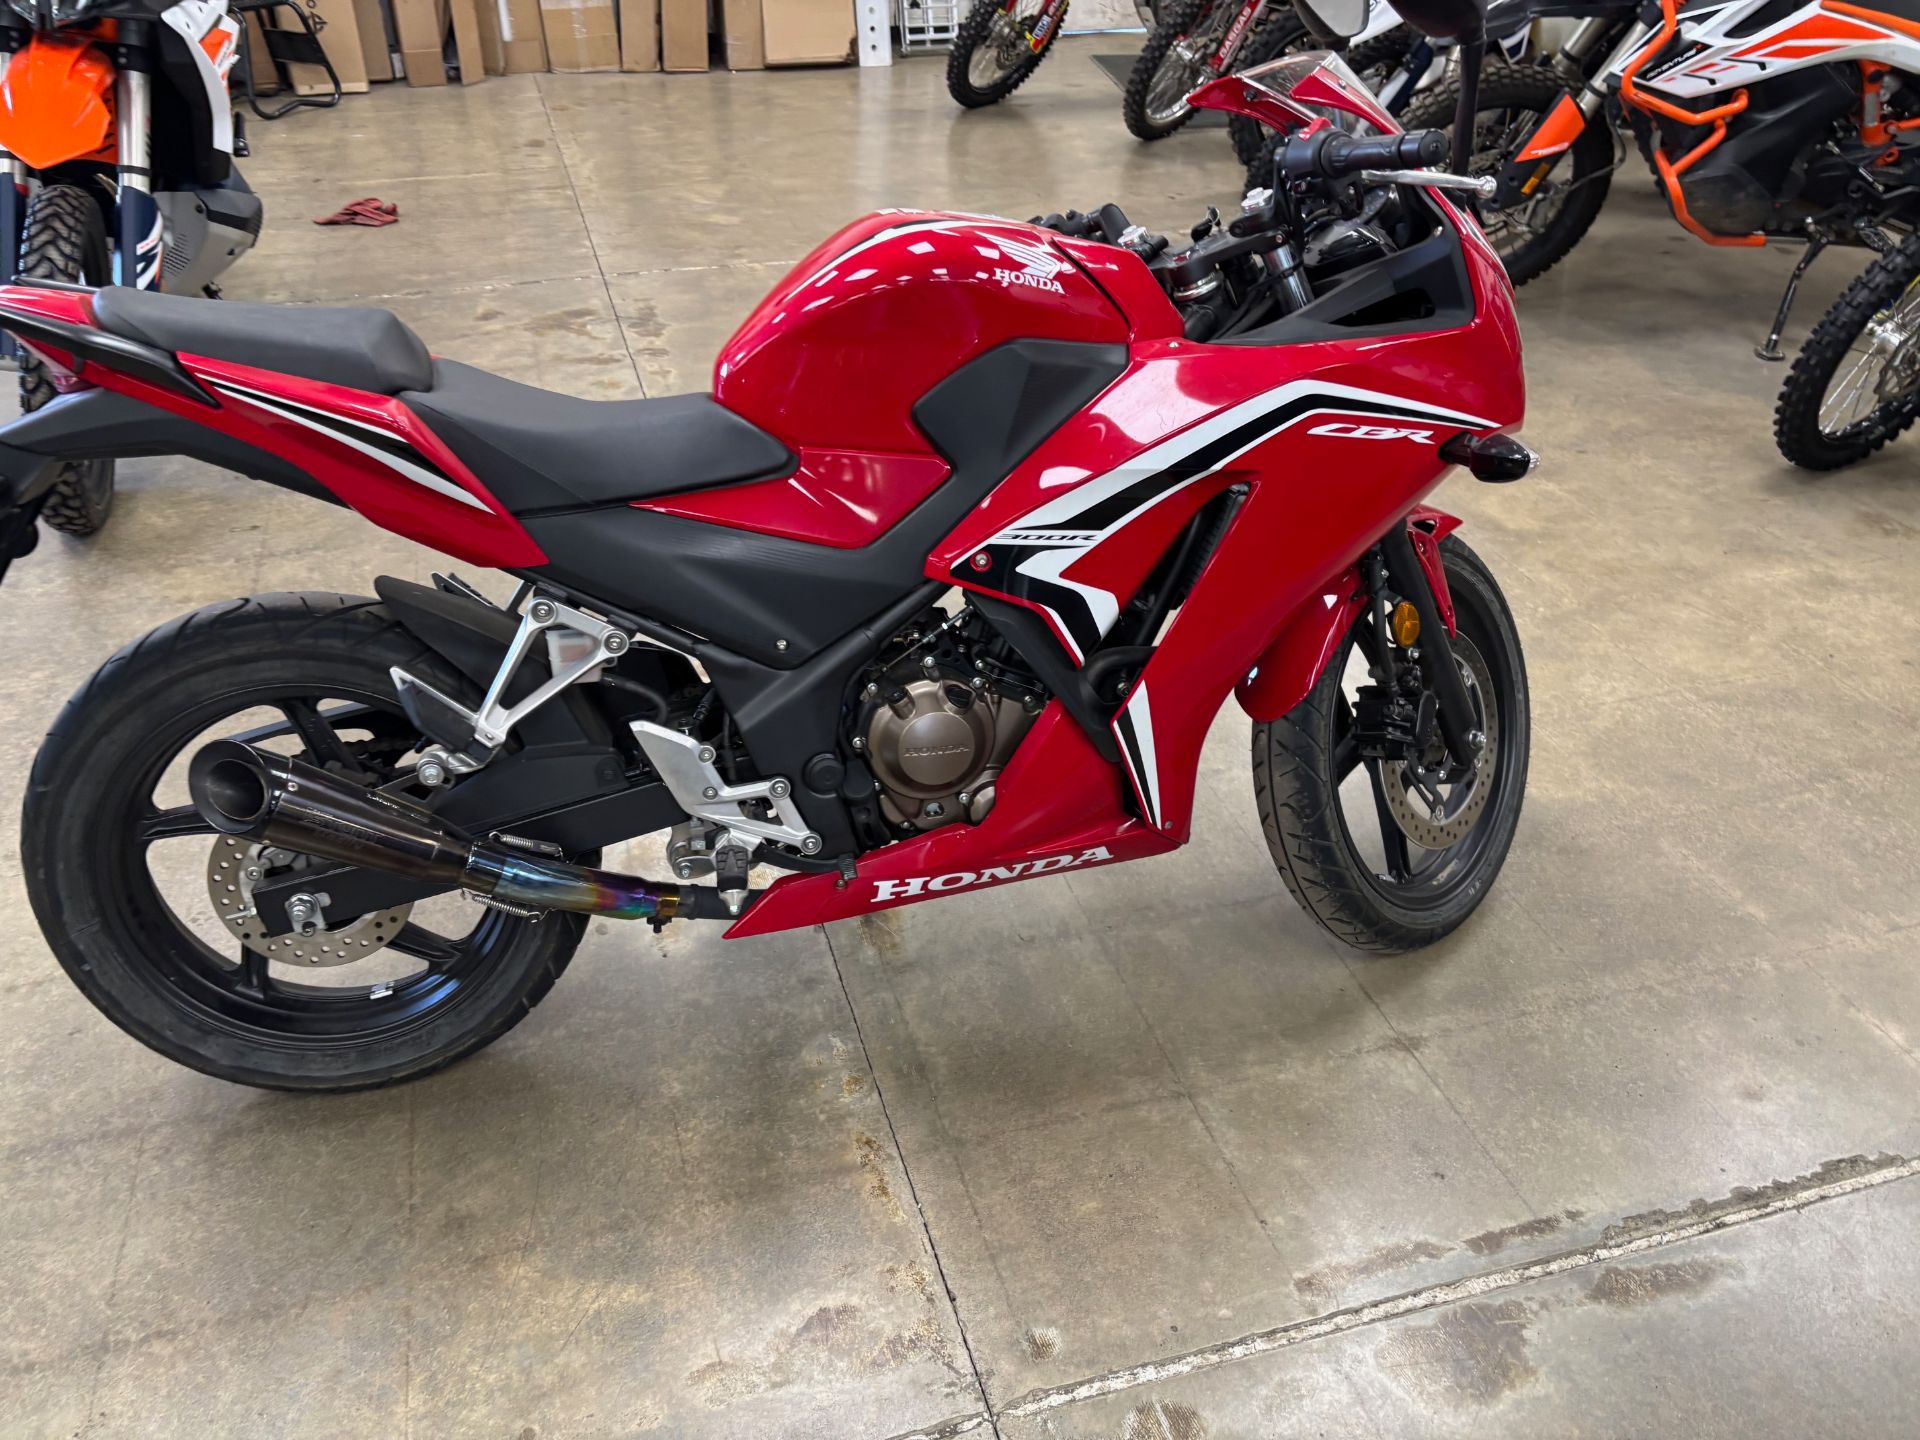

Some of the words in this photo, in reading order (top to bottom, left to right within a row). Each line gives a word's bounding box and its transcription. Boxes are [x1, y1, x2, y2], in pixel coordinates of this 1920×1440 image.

[992, 267, 1066, 295] HONDA
[1306, 422, 1437, 445] CBR
[995, 533, 1098, 542] 300R
[903, 745, 970, 757] HONDA
[870, 845, 1115, 903] HONDA
